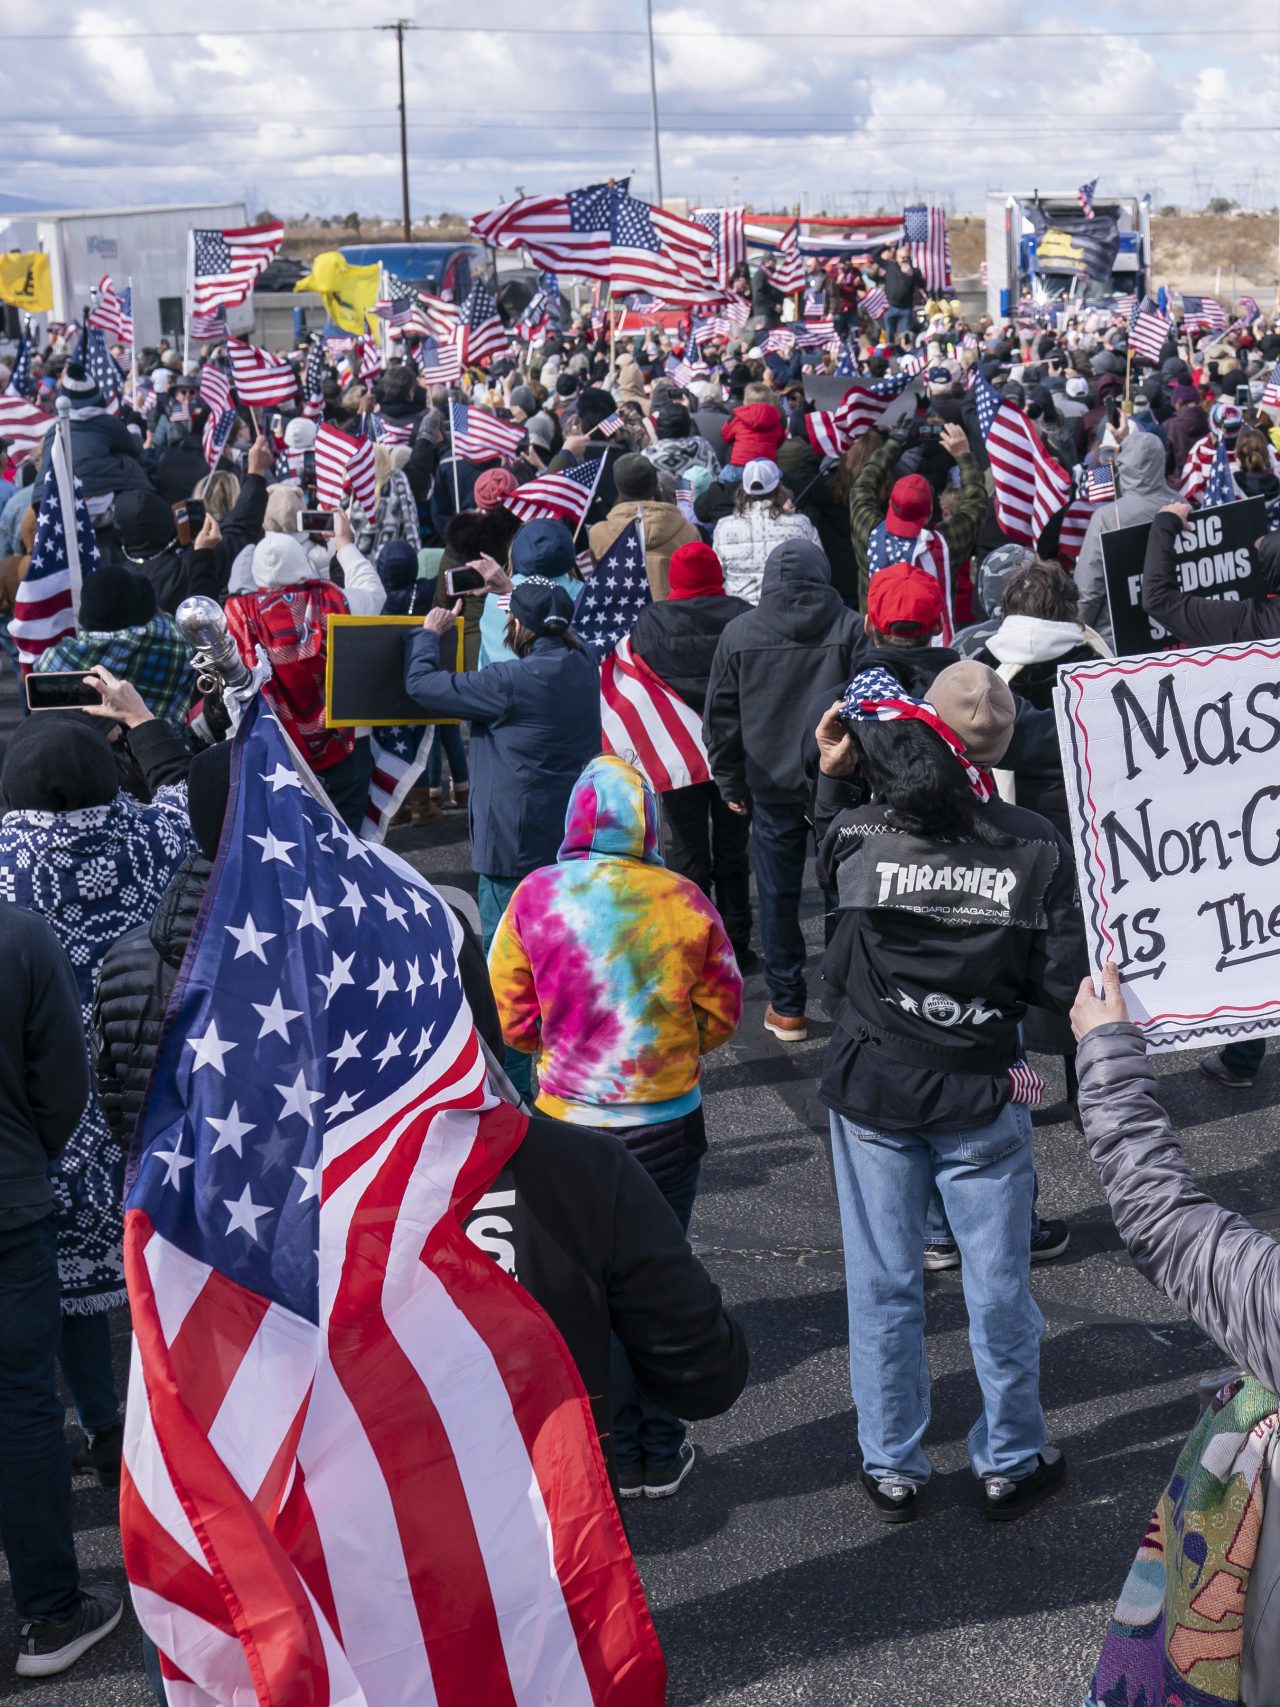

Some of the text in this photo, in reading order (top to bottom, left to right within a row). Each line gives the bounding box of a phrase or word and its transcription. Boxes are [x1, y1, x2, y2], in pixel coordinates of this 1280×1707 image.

[1127, 548, 1252, 606] FDOMS
[876, 862, 1017, 910] THRASHER
[952, 907, 1010, 918] MAGAZINE
